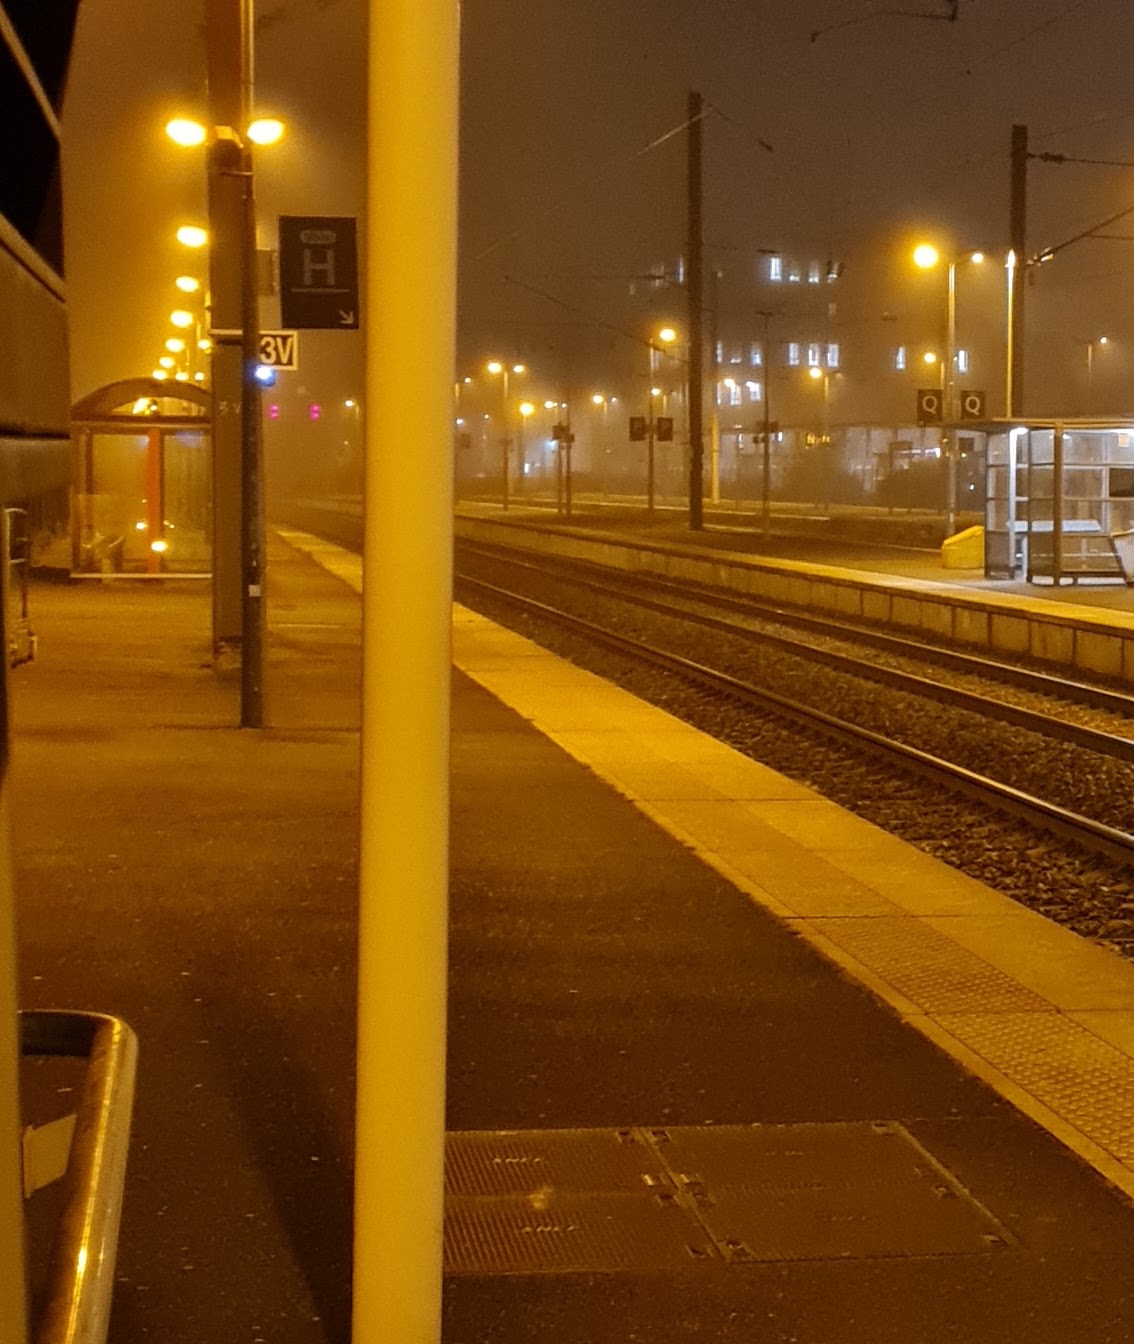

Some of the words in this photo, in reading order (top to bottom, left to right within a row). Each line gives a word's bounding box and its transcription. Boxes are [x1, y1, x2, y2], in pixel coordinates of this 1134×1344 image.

[303, 248, 336, 286] H
[260, 336, 293, 365] 3V
[922, 395, 938, 414] Q
[965, 396, 981, 416] Q
